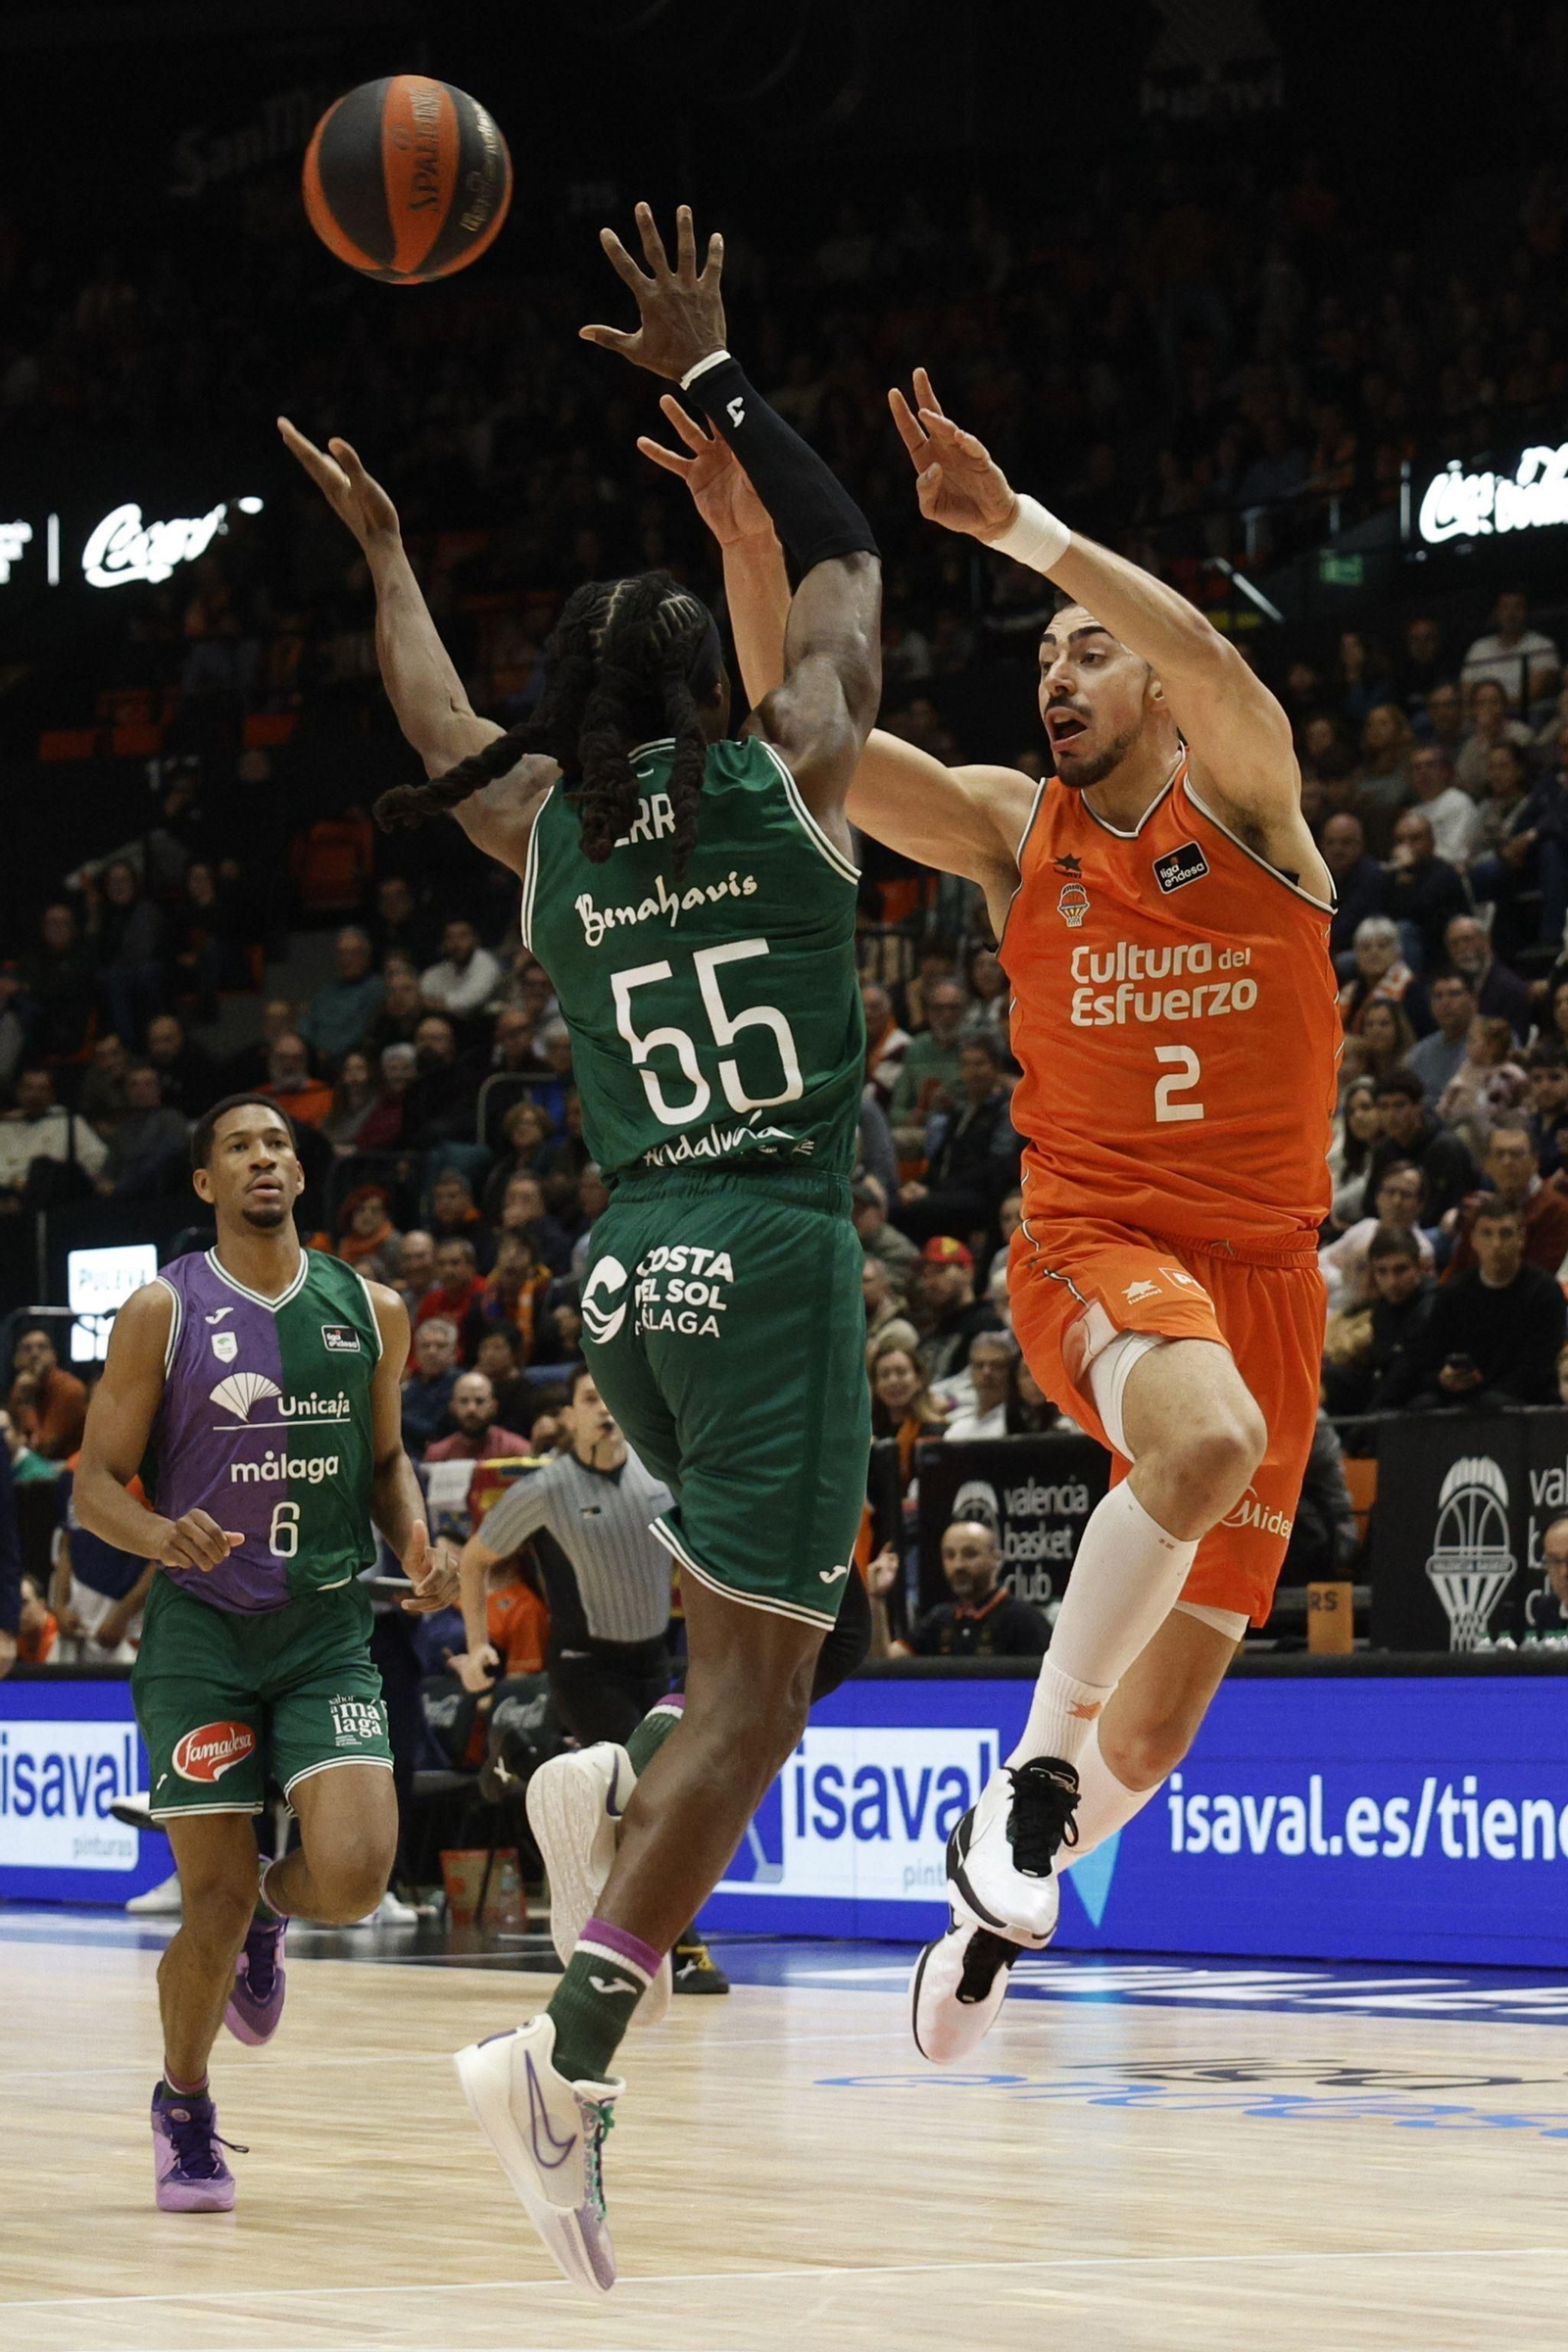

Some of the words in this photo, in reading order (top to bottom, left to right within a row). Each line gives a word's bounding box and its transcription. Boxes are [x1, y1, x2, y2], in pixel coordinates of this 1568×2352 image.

[1159, 863, 1181, 879] liga
[1163, 862, 1205, 888] endesa
[1070, 941, 1212, 984] Cultura
[1218, 947, 1250, 970] del
[1070, 978, 1258, 1027] Esfuerzo
[610, 937, 804, 1125] 55
[1153, 1045, 1204, 1122] 2
[636, 1245, 734, 1284] COSTA
[664, 1278, 727, 1311] SOL
[277, 1391, 351, 1418] Unicaja
[1004, 1475, 1090, 1516] valencia
[269, 1501, 301, 1558] 6
[1004, 1521, 1074, 1561] basket
[1003, 1562, 1053, 1601] club
[332, 1714, 383, 1739] laga
[1, 1732, 131, 1819] isaval
